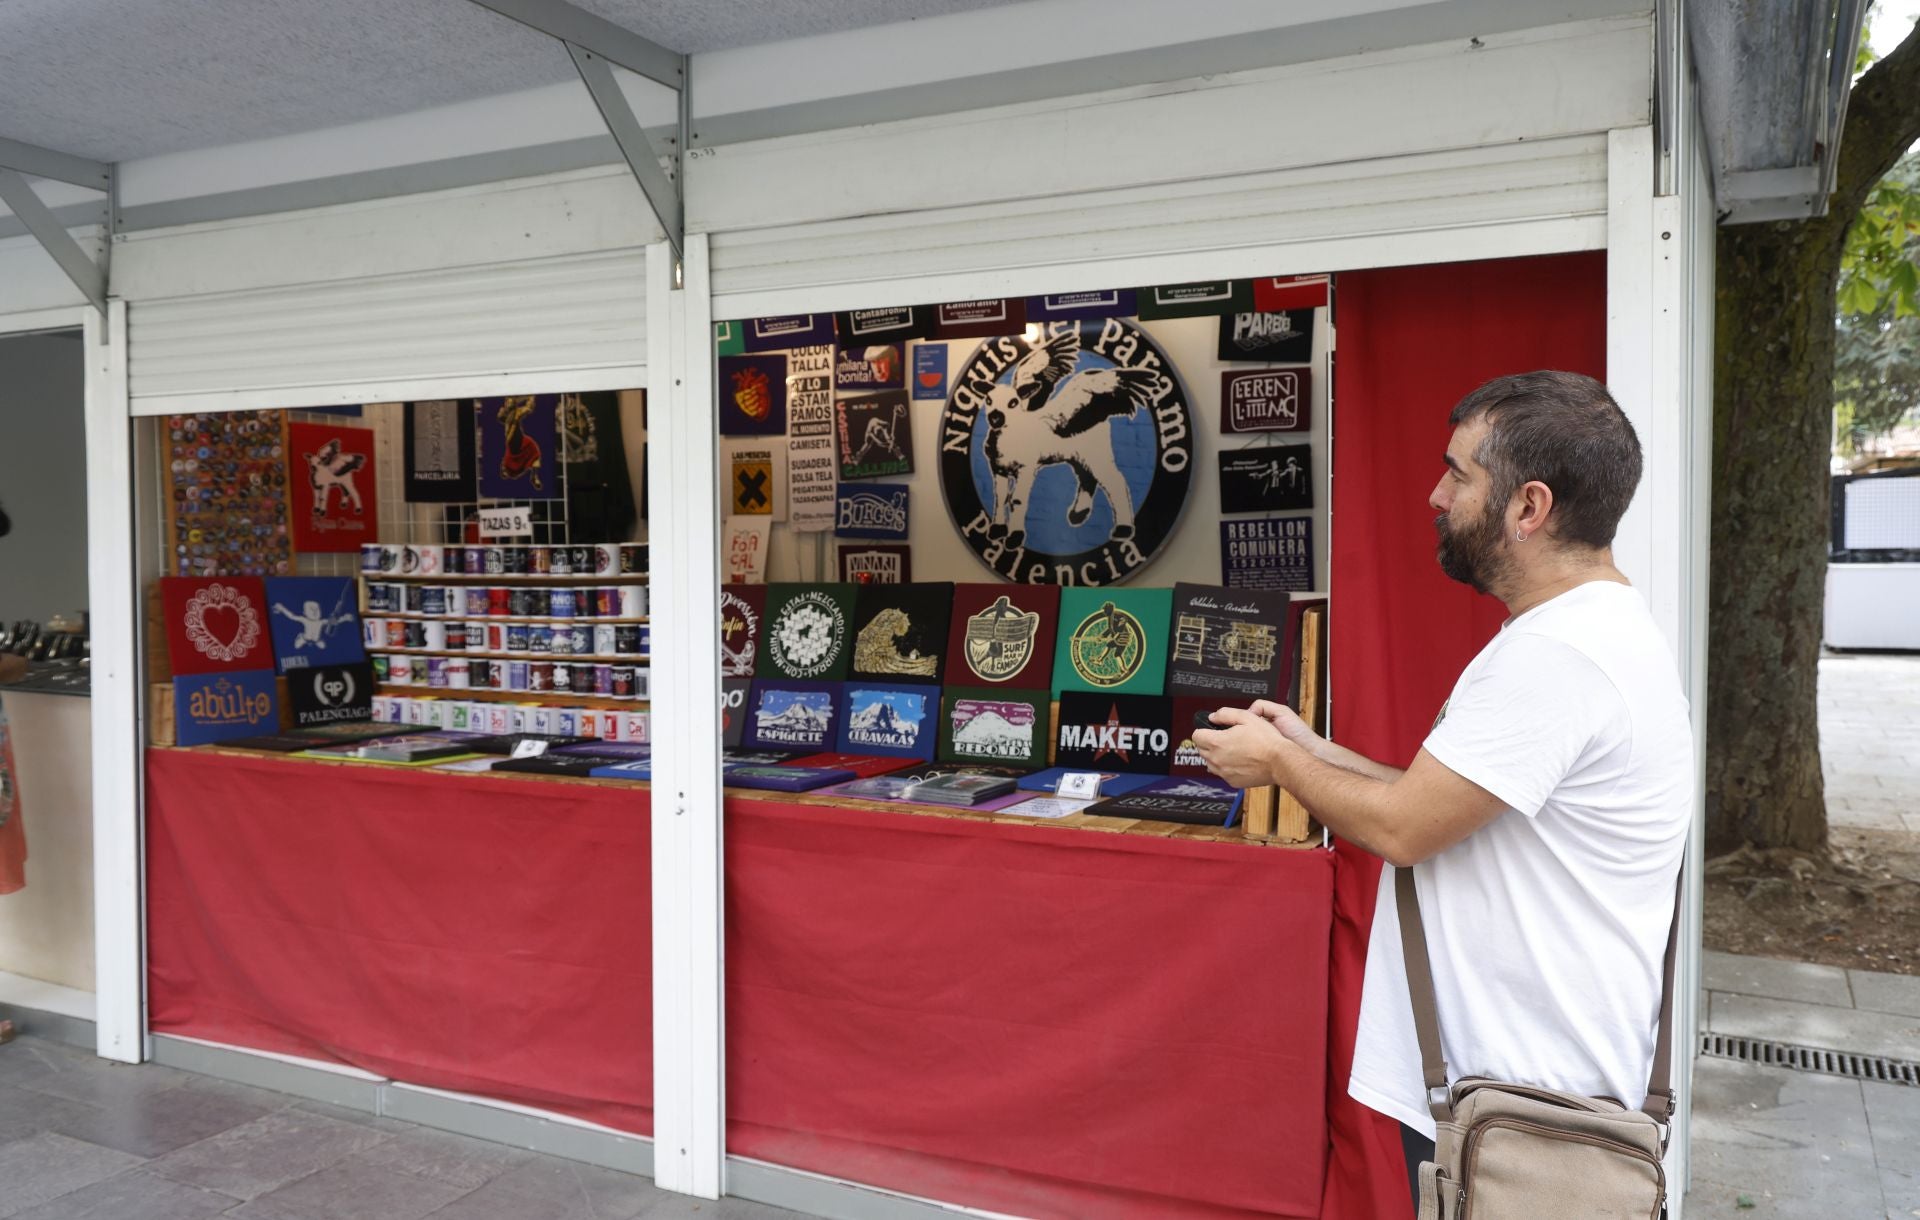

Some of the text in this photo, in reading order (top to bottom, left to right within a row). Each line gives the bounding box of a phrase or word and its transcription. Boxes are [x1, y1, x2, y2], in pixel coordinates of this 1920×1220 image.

[791, 345, 830, 357] COLOR
[791, 358, 830, 372] TALLA
[806, 379, 821, 390] LO
[791, 393, 830, 407] ESTAM
[791, 406, 831, 420] PAMOS
[790, 439, 831, 450] CAMISETA
[791, 458, 832, 470] SUDADERA
[792, 471, 833, 484] BOLSA TELA
[482, 517, 511, 531] TAZAS
[1228, 520, 1307, 539] REBELION
[962, 509, 1147, 587] Palencia
[1229, 539, 1306, 557] COMUNERA
[1004, 641, 1026, 653] SURF
[190, 685, 270, 725] abulto
[848, 729, 915, 746] CURAVACAS
[1060, 725, 1168, 753] MAKETO
[954, 741, 1032, 757] REDONDA
